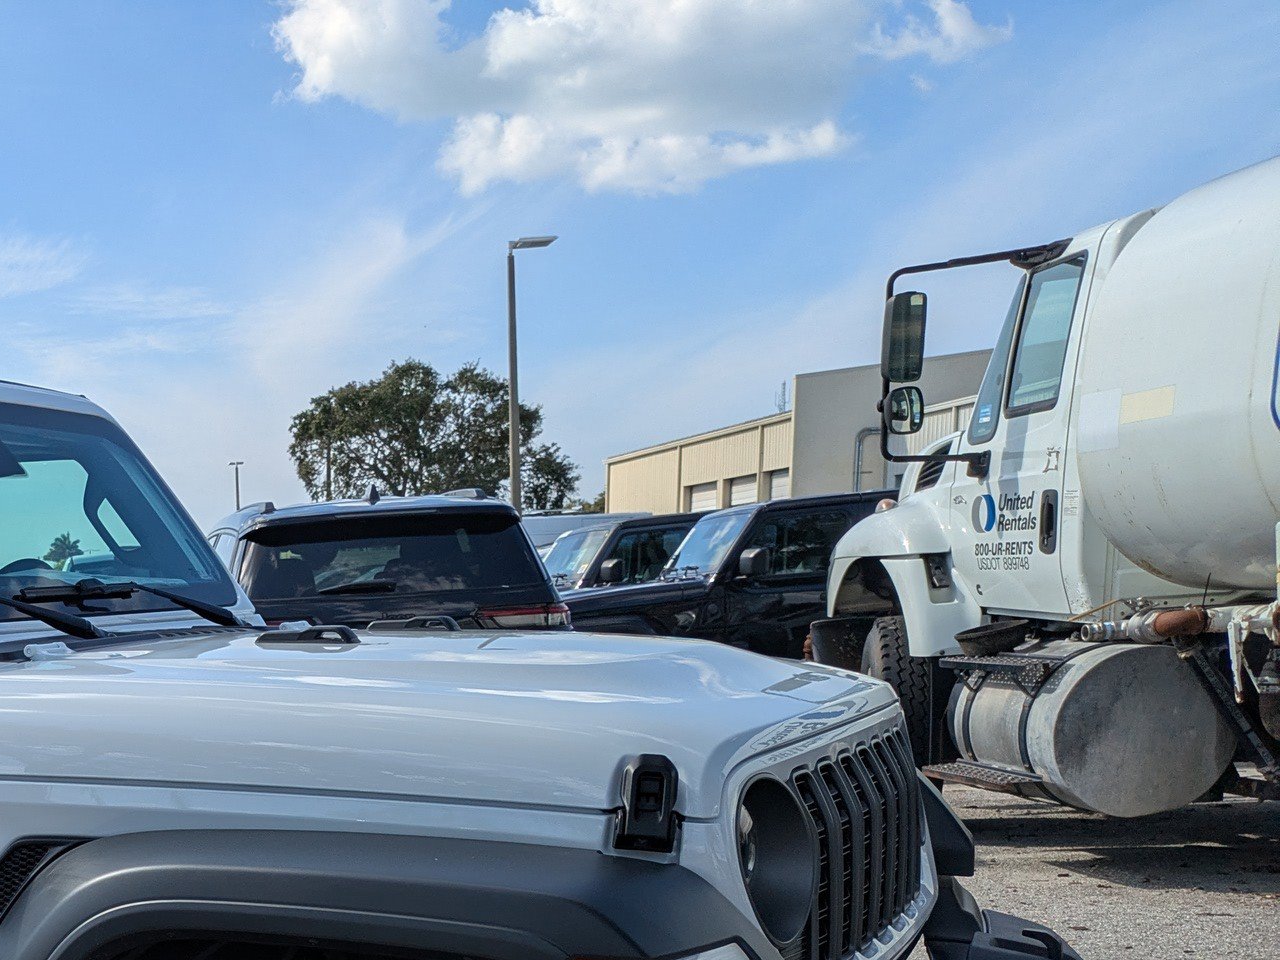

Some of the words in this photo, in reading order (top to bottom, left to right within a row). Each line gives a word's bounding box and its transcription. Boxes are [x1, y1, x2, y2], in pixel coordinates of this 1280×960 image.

[998, 490, 1035, 512] United
[997, 512, 1037, 532] Rentals
[974, 541, 1034, 557] 800-UR-RENTS
[977, 558, 1001, 570] USDOT
[1003, 557, 1030, 571] 899748
